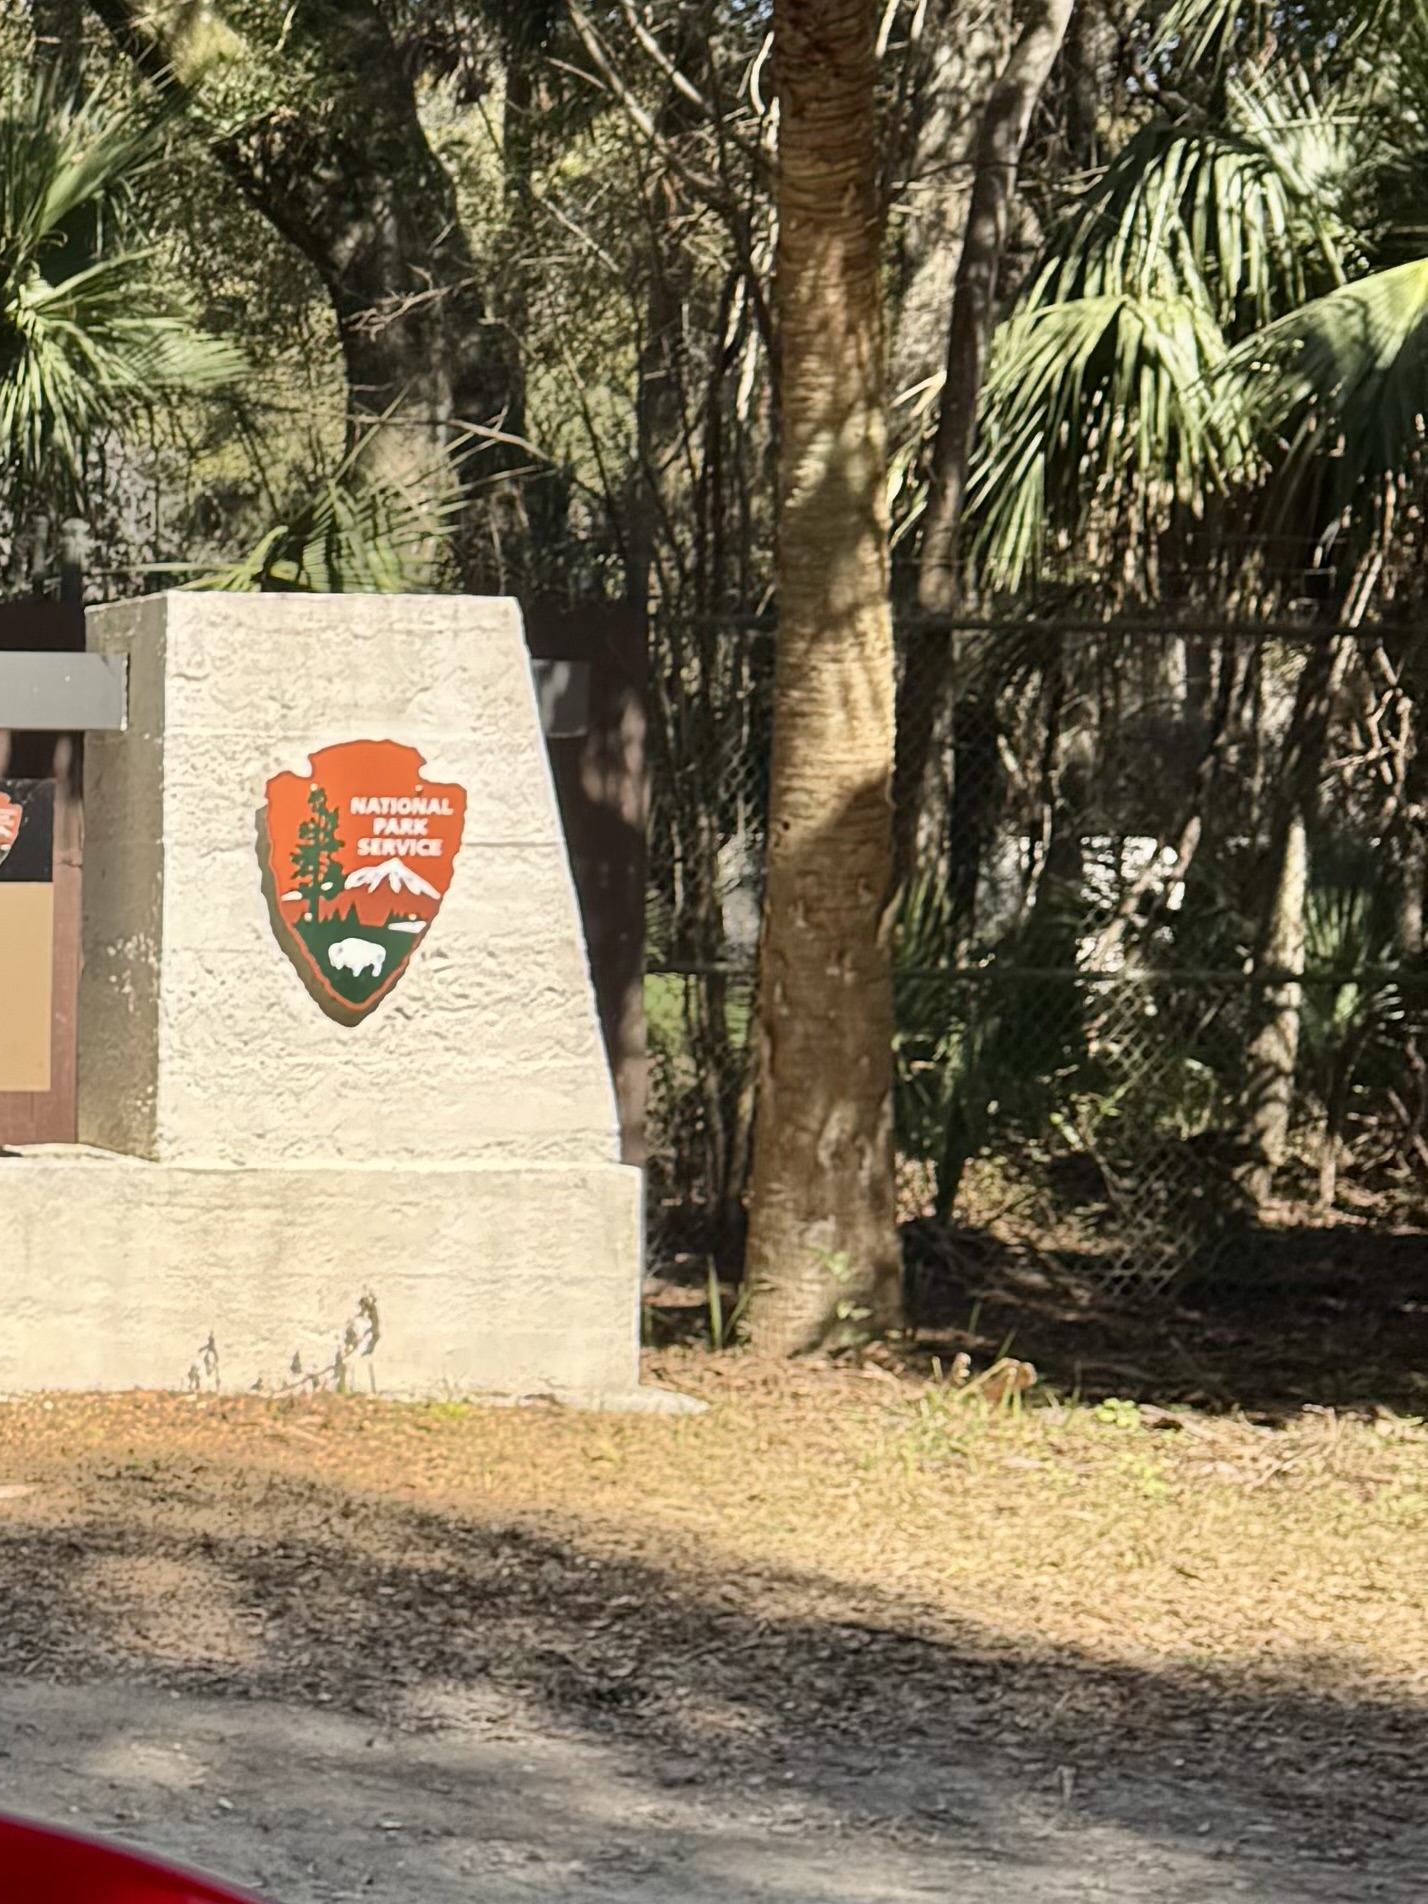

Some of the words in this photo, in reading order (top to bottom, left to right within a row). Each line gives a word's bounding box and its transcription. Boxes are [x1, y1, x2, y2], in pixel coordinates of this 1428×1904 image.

[350, 796, 454, 815] NATIONAL
[372, 817, 429, 836] PARK
[357, 838, 443, 857] SERVICE
